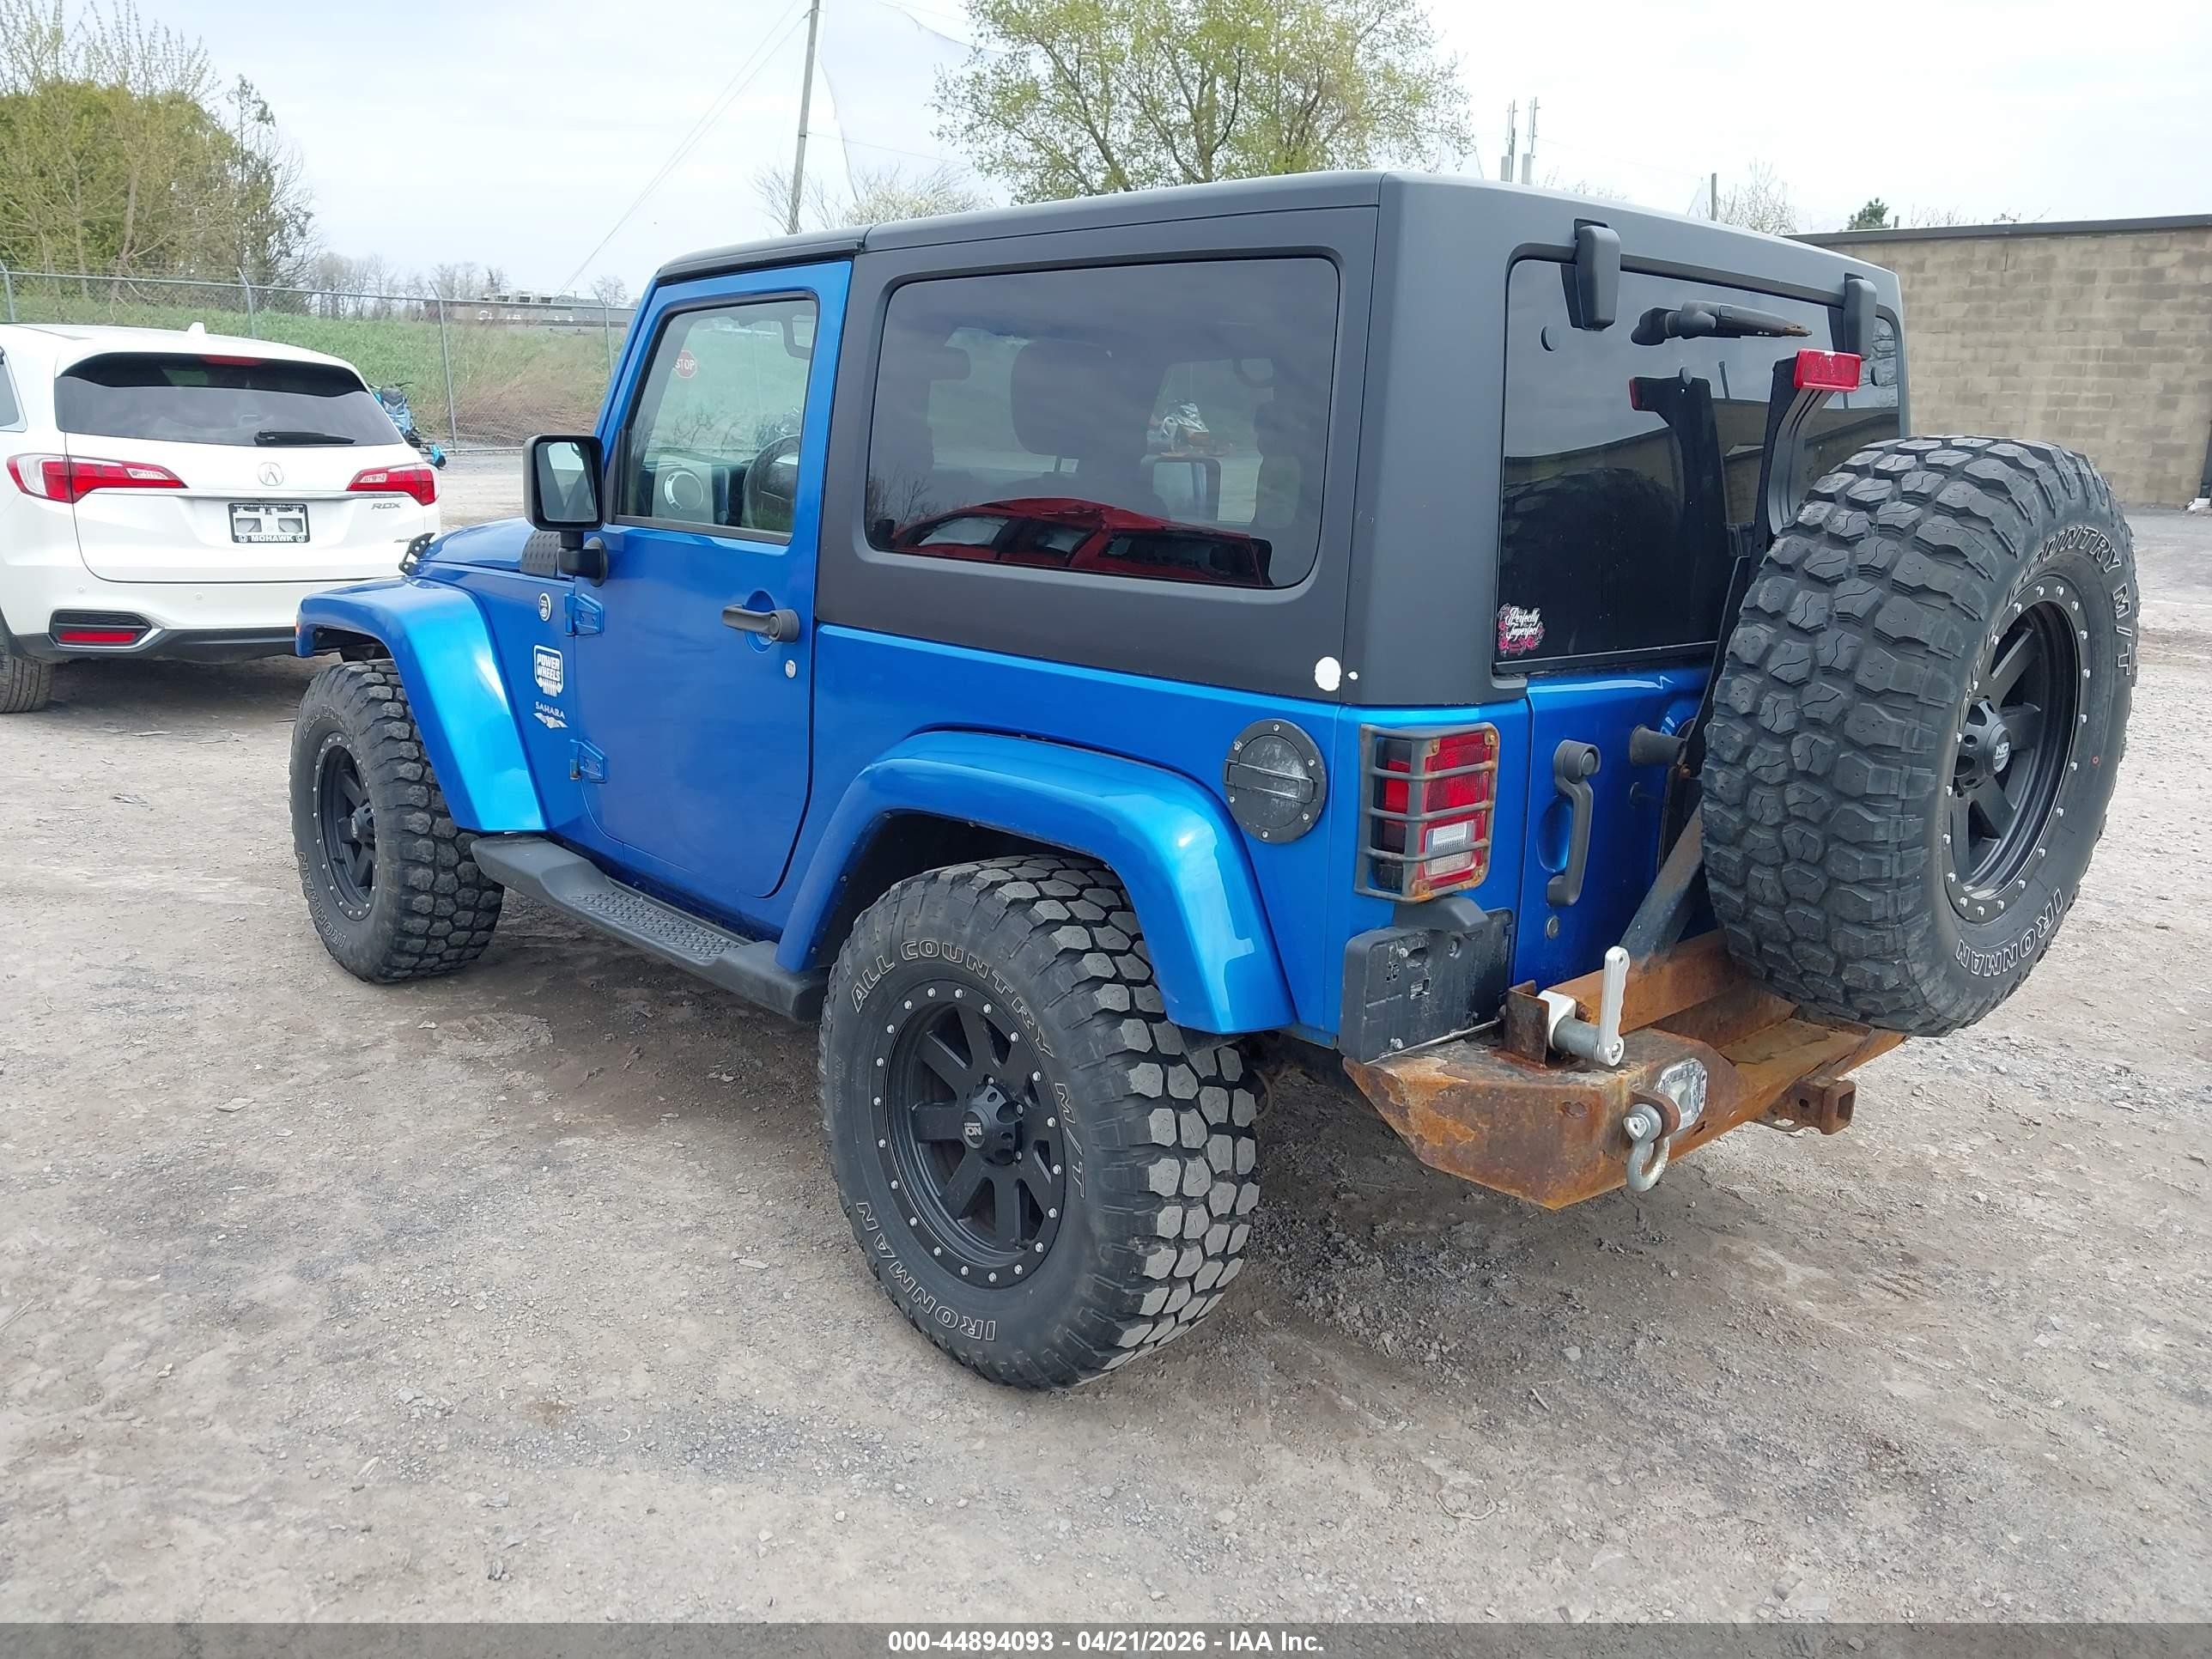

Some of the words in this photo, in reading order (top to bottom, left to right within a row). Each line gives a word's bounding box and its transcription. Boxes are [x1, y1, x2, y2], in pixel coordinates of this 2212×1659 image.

[675, 359, 695, 370] STOP
[2112, 583, 2132, 676] M/T
[537, 653, 560, 670] POWER
[537, 665, 561, 681] WHEELS
[535, 702, 565, 719] SAHARA
[1956, 888, 2063, 976] IRONMAN
[851, 955, 896, 1013] ALL
[900, 939, 1054, 1058] COUNTRY
[1055, 1083, 1085, 1200] M/T
[856, 1202, 996, 1341] IRONMAN
